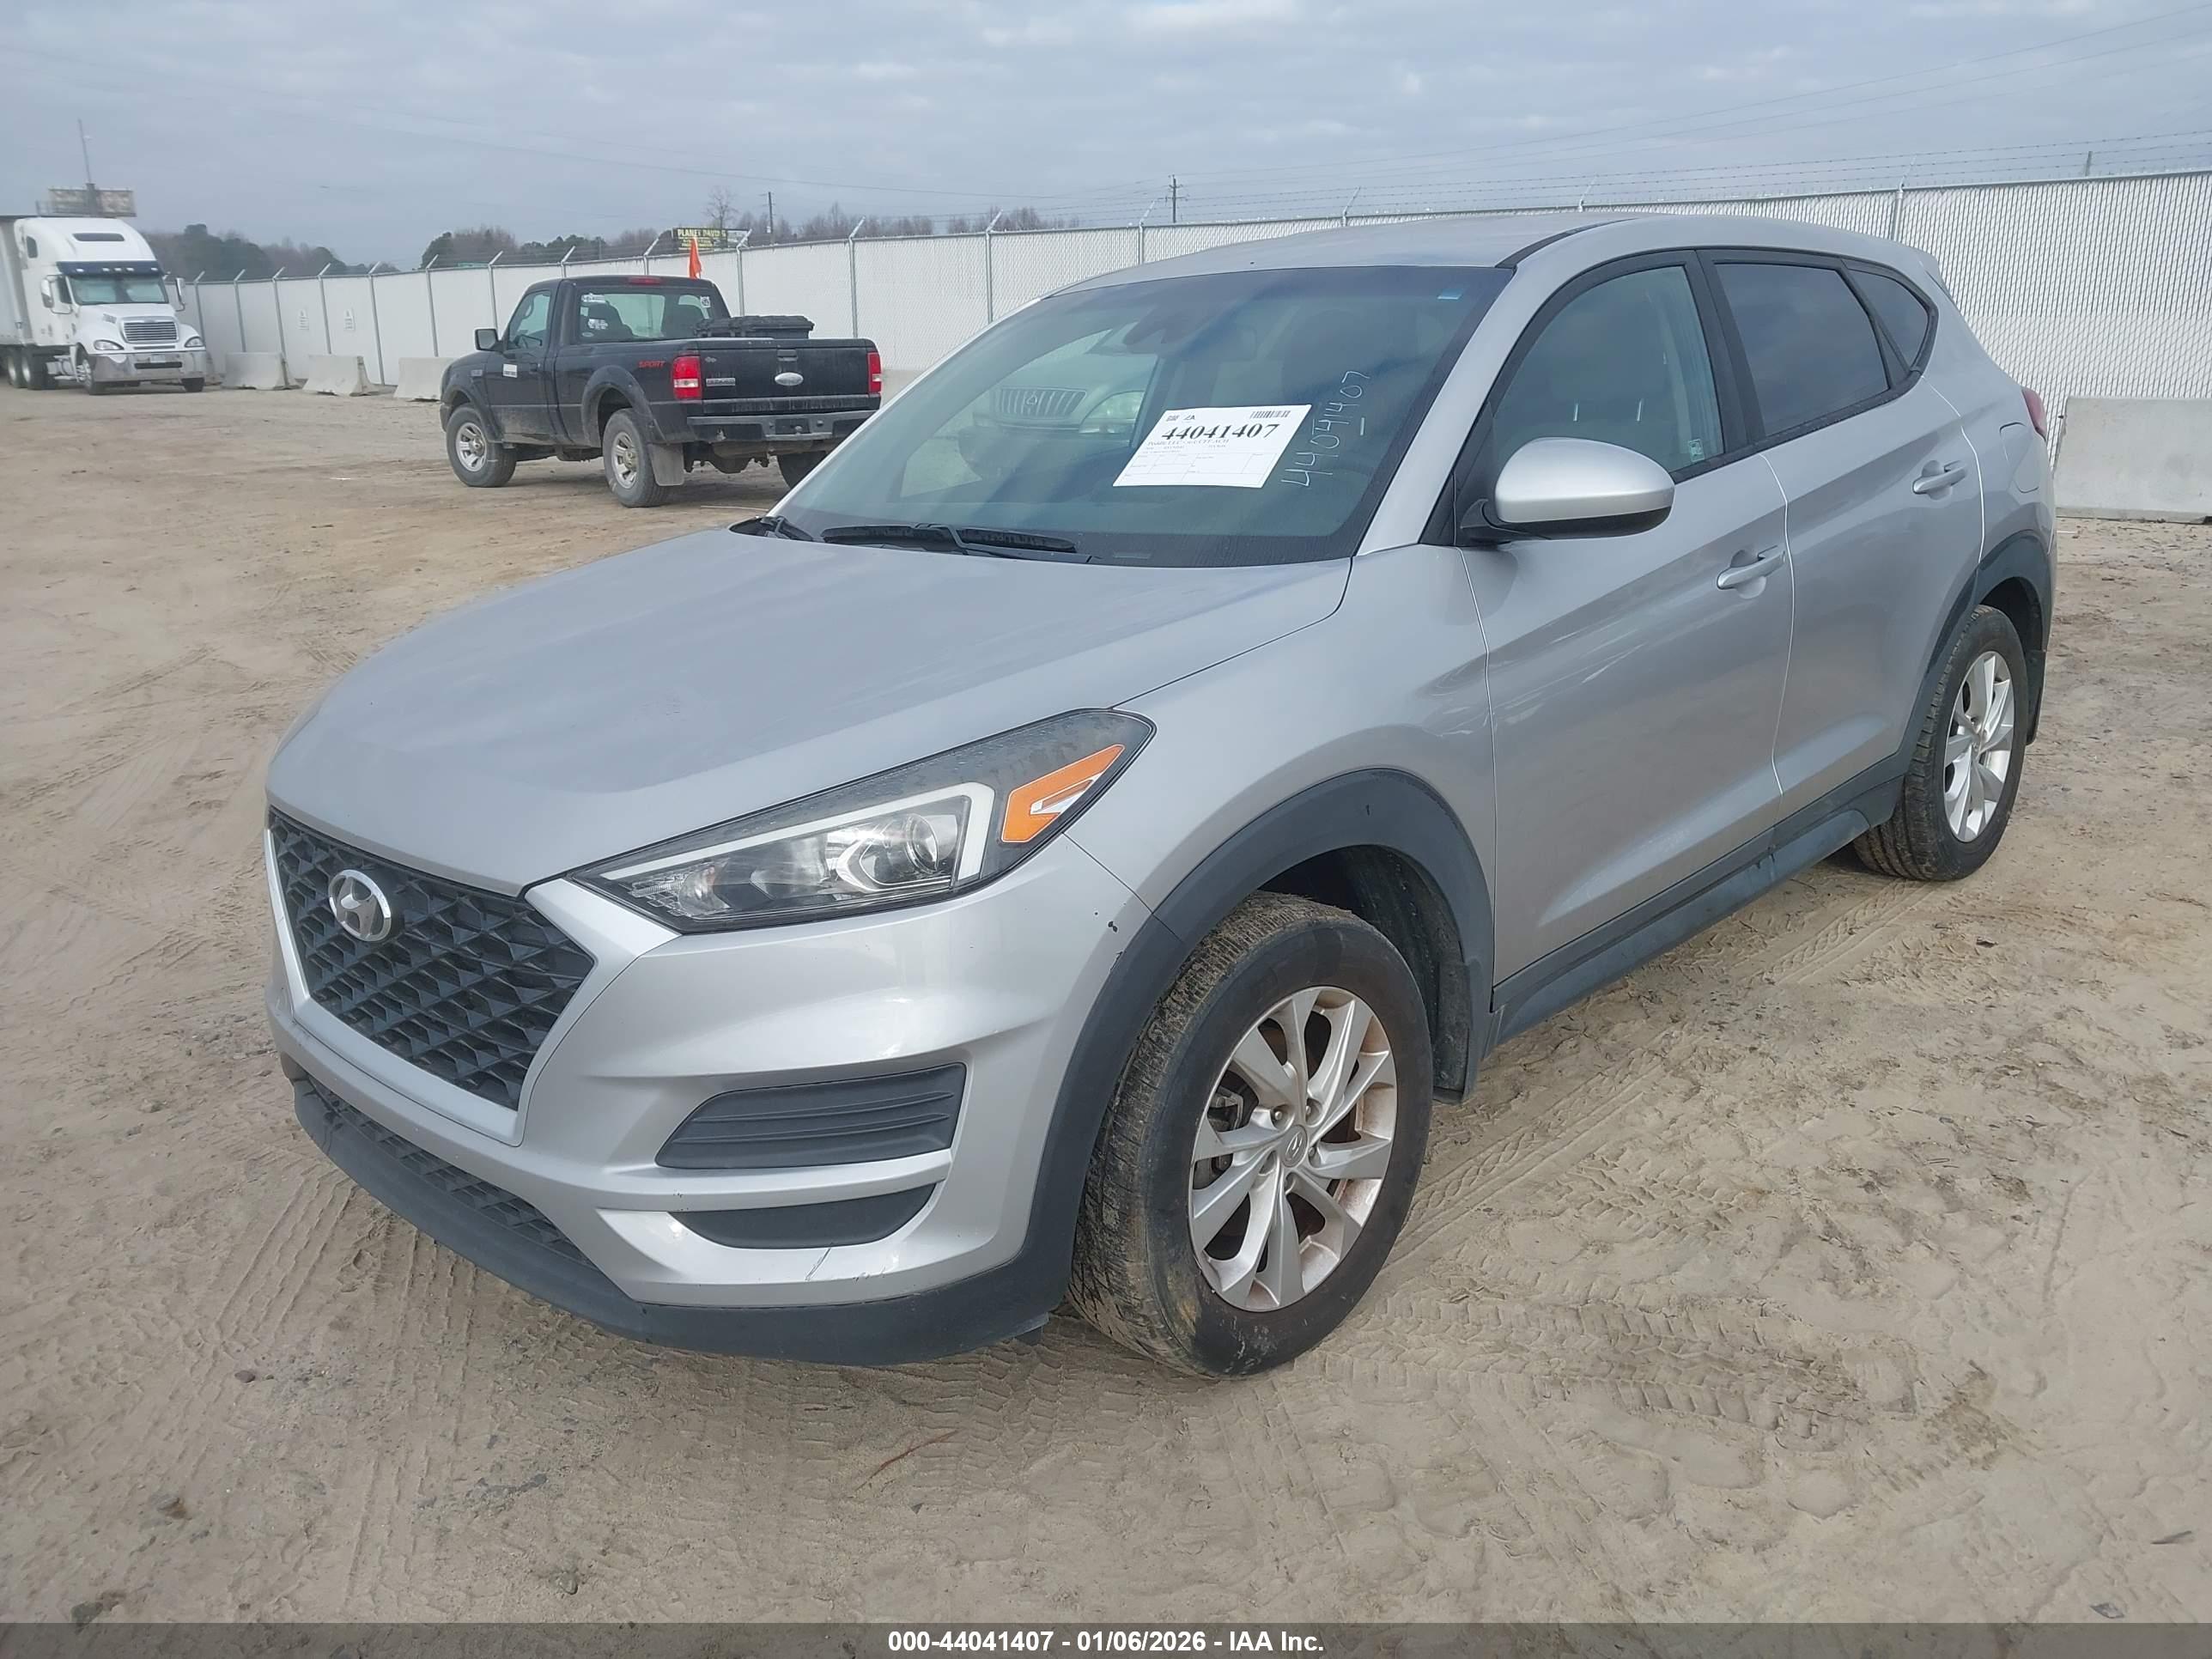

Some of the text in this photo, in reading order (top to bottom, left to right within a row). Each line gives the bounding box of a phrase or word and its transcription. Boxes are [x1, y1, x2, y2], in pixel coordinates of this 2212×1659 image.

[638, 359, 666, 369] SPORT
[1162, 422, 1280, 441] 44041407
[1280, 370, 1370, 487] 44041407
